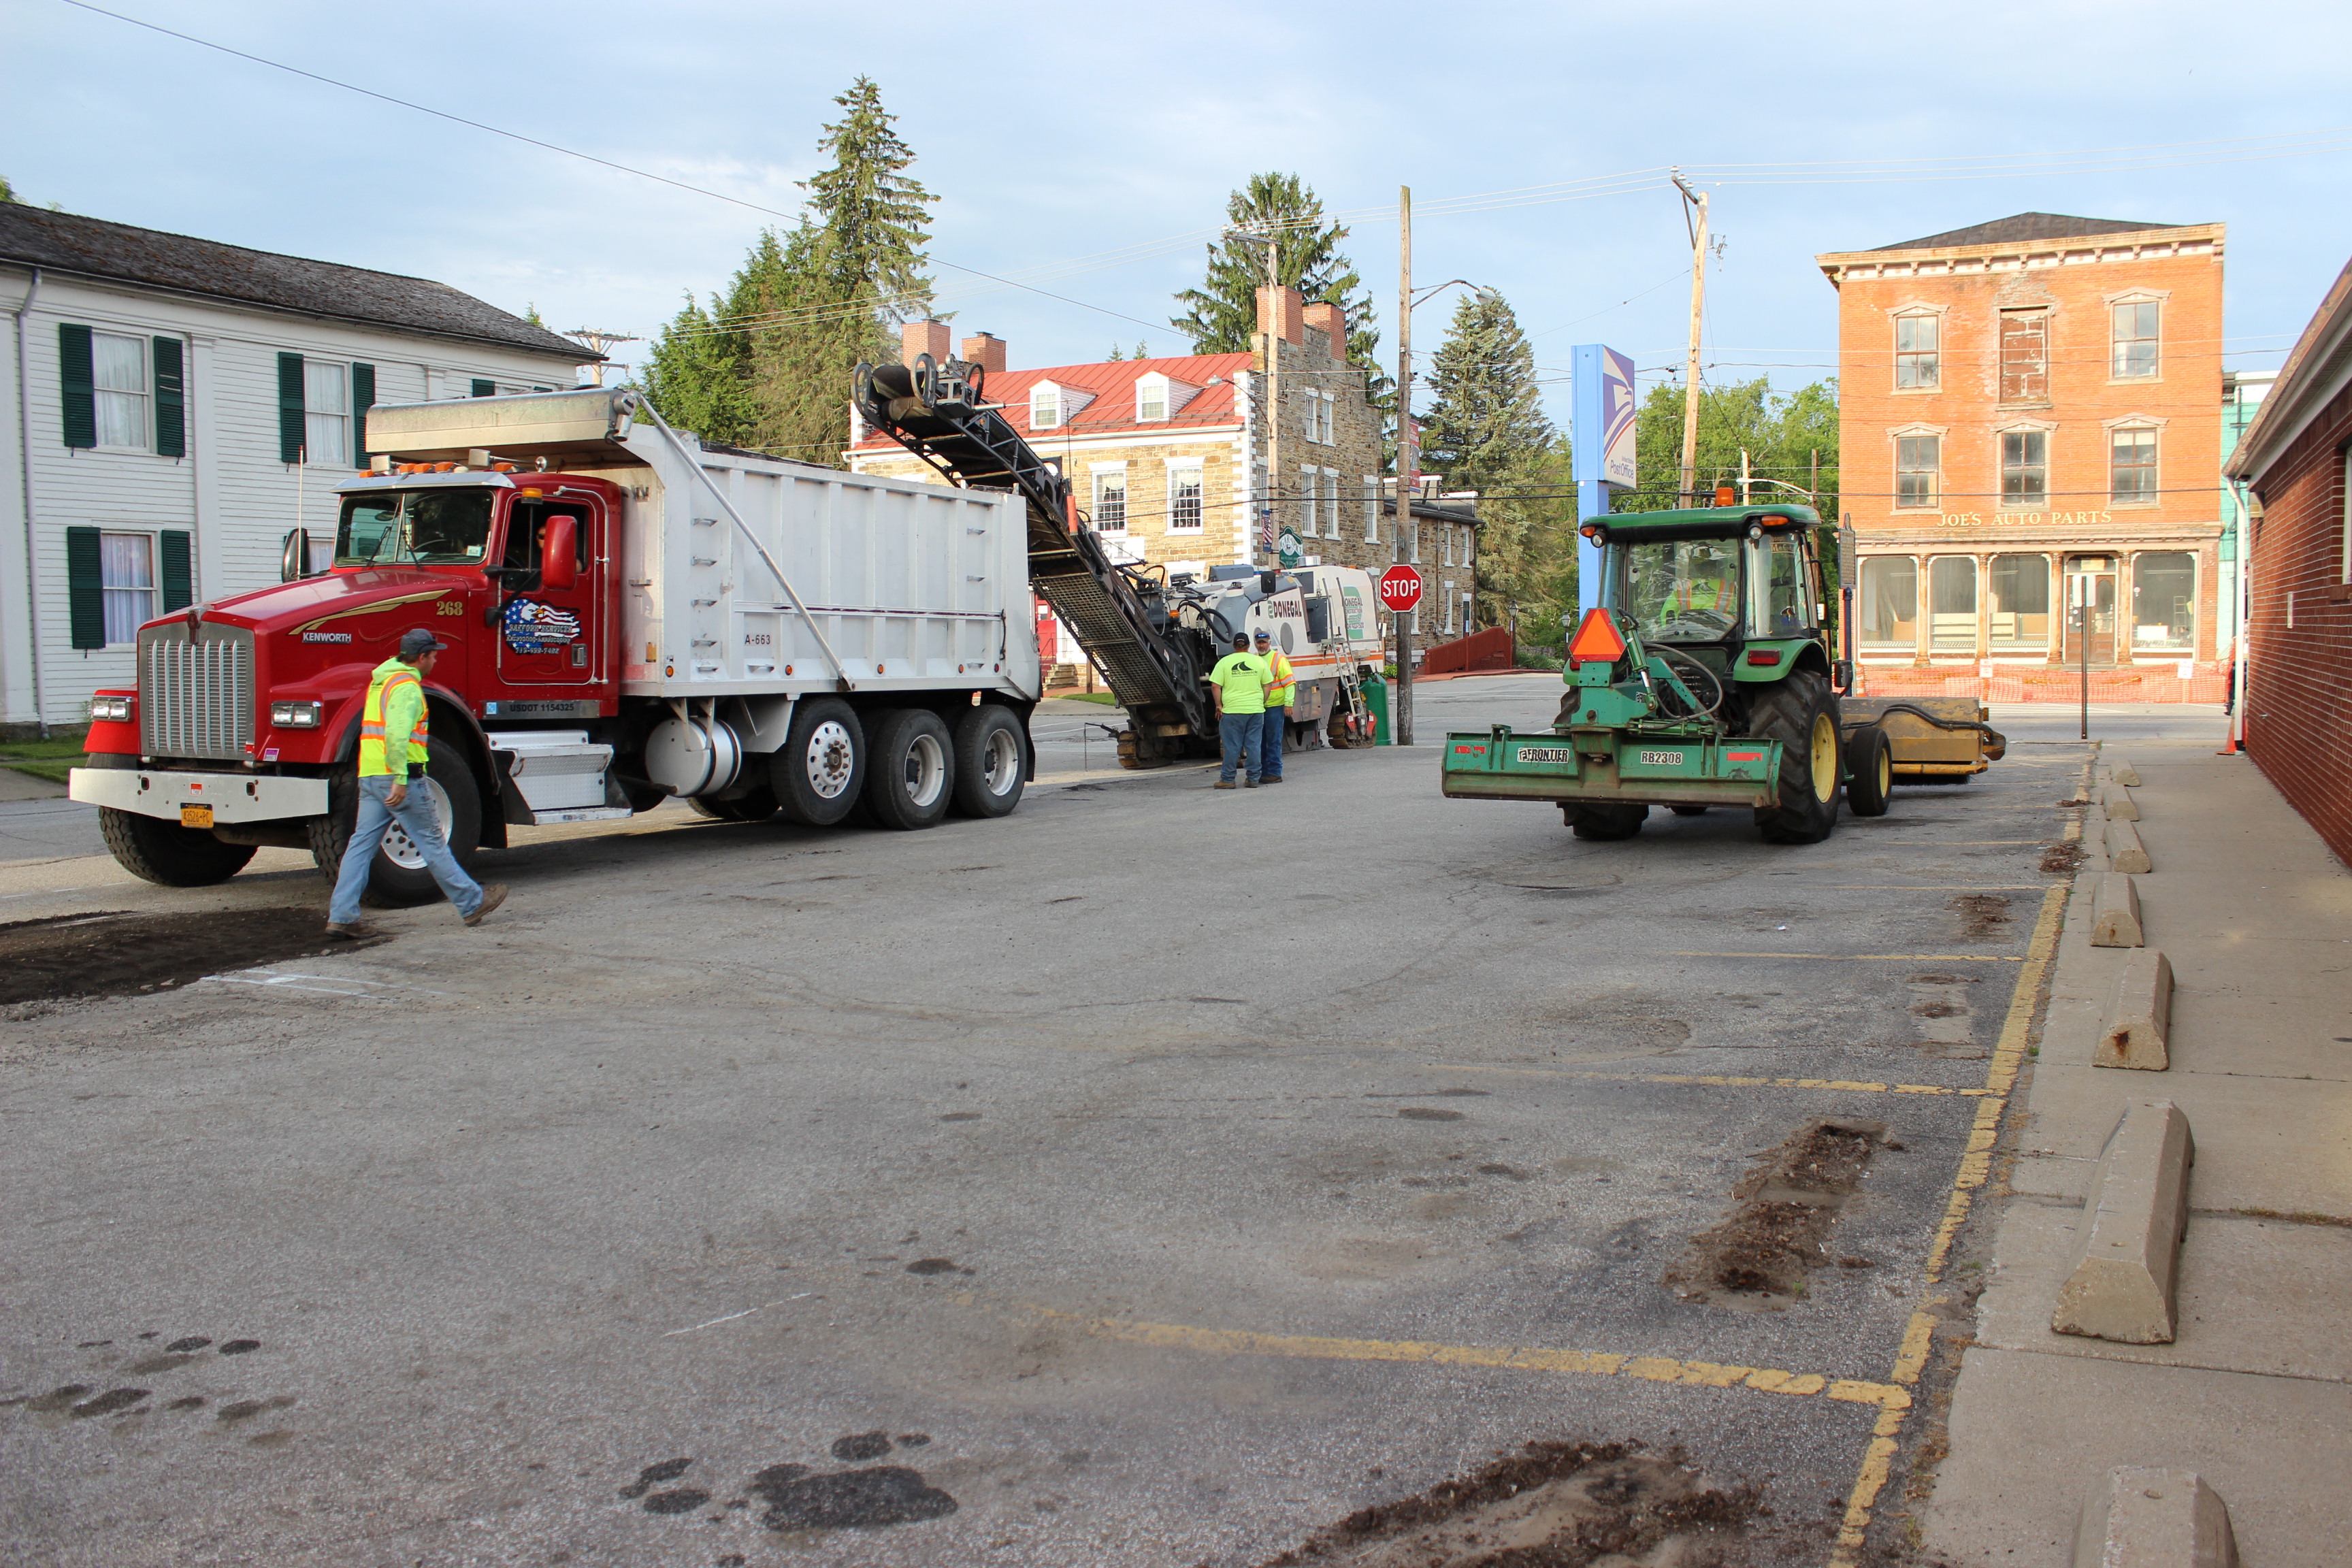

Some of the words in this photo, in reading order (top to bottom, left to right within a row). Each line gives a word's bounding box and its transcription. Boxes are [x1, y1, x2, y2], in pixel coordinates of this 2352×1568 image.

[1610, 459, 1620, 475] Post
[1621, 463, 1634, 479] Office
[1937, 512, 1982, 527] JOE'S
[1991, 512, 2041, 525] AUTO
[2051, 510, 2112, 524] PARTS
[1382, 579, 1419, 598] STOP
[1345, 598, 1363, 606] ONEGAL
[436, 601, 463, 616] 268
[1273, 600, 1302, 618] DONEGAL
[541, 625, 572, 633] SERVICES
[303, 632, 351, 642] KENWORTH
[745, 634, 770, 644] A-663
[1527, 749, 1568, 760] FRONTIER
[1642, 752, 1682, 764] RB2308
